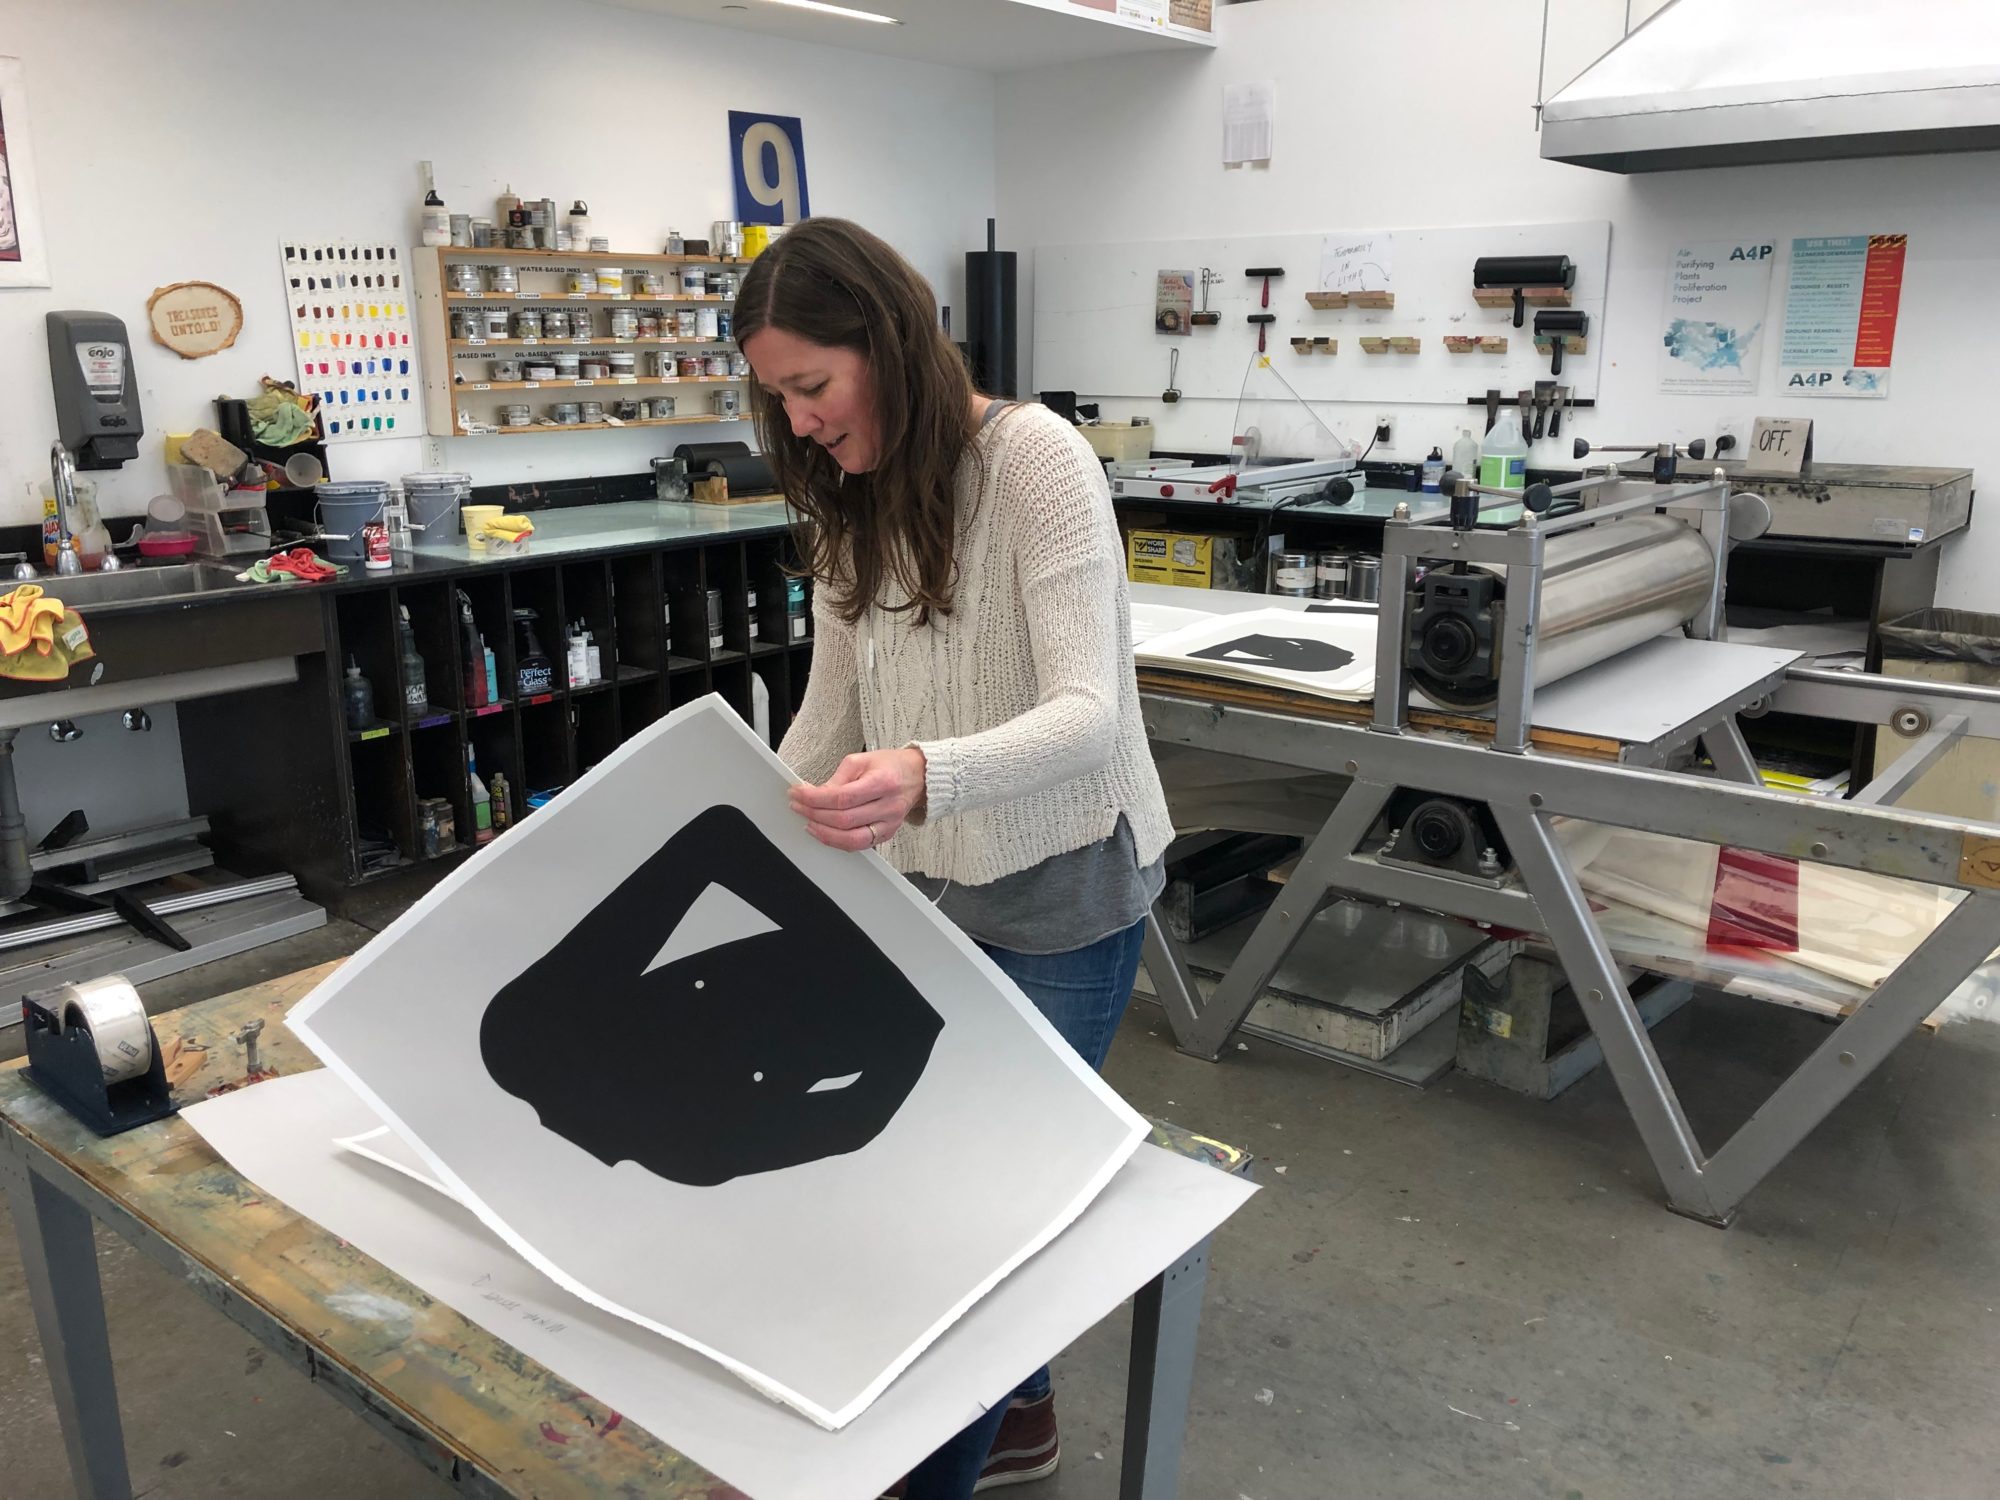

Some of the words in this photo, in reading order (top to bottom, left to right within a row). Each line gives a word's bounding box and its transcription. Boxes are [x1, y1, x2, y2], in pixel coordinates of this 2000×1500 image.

[742, 122, 800, 224] 9
[1730, 245, 1772, 260] A4P
[1676, 260, 1714, 270] Purifying
[1674, 272, 1700, 280] Plants
[1674, 282, 1728, 292] Proliferation
[1672, 294, 1702, 304] Project
[1788, 372, 1832, 386] A4P
[520, 666, 552, 679] Perfect
[523, 676, 548, 686] Glass
